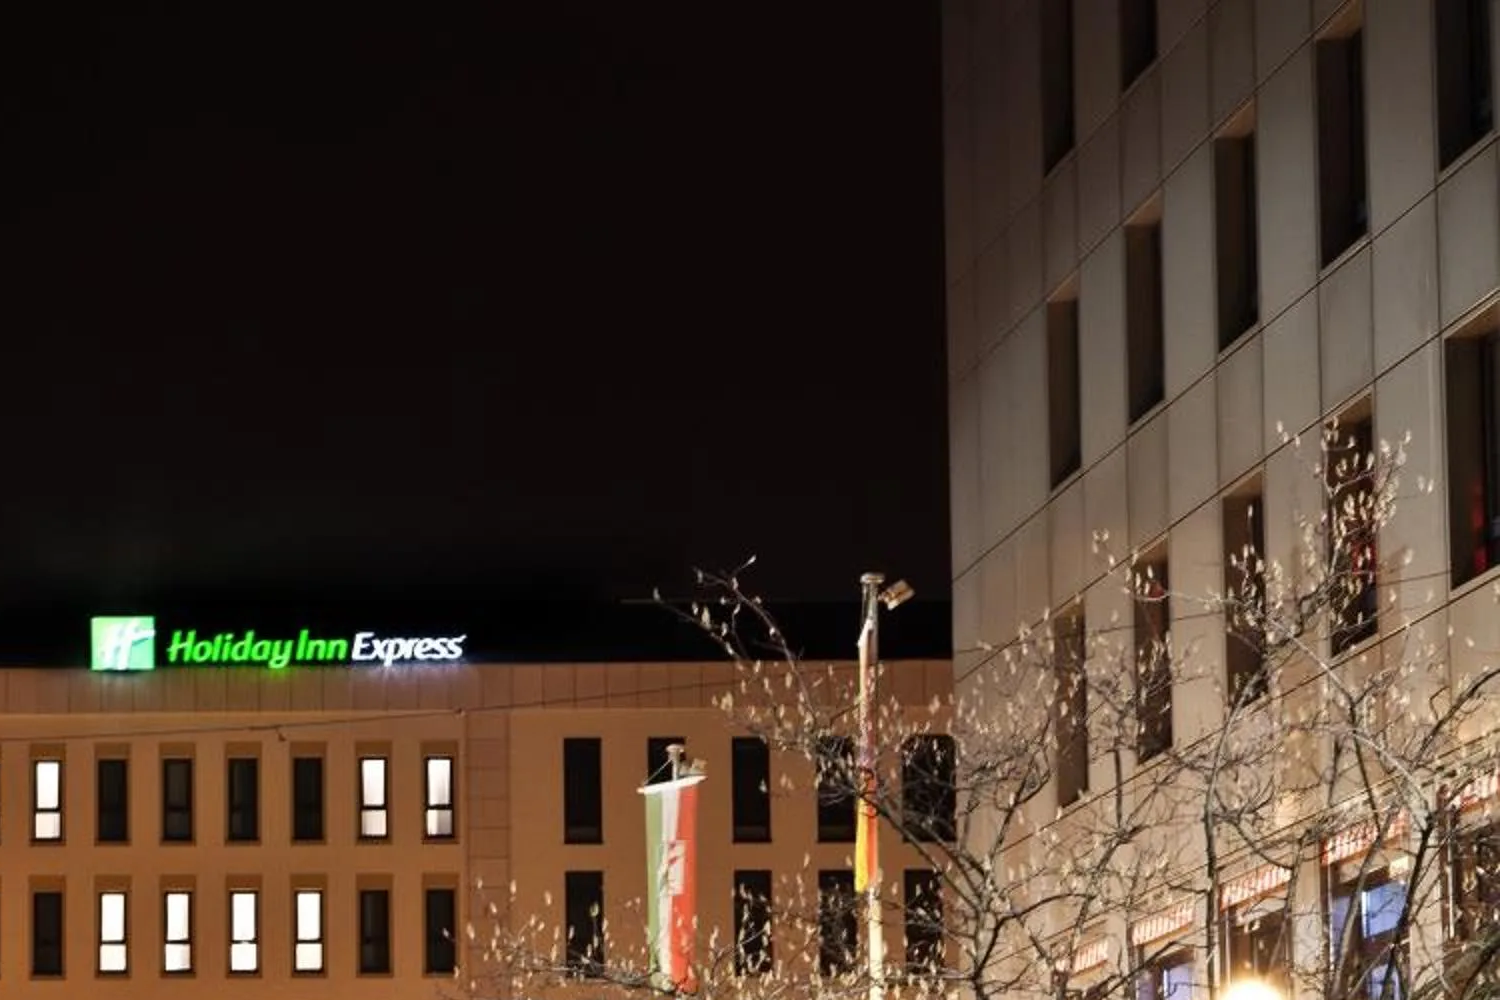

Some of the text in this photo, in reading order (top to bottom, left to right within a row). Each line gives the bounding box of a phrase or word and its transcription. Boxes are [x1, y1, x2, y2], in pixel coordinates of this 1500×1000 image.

[167, 629, 467, 669] Holiday Inn Express
